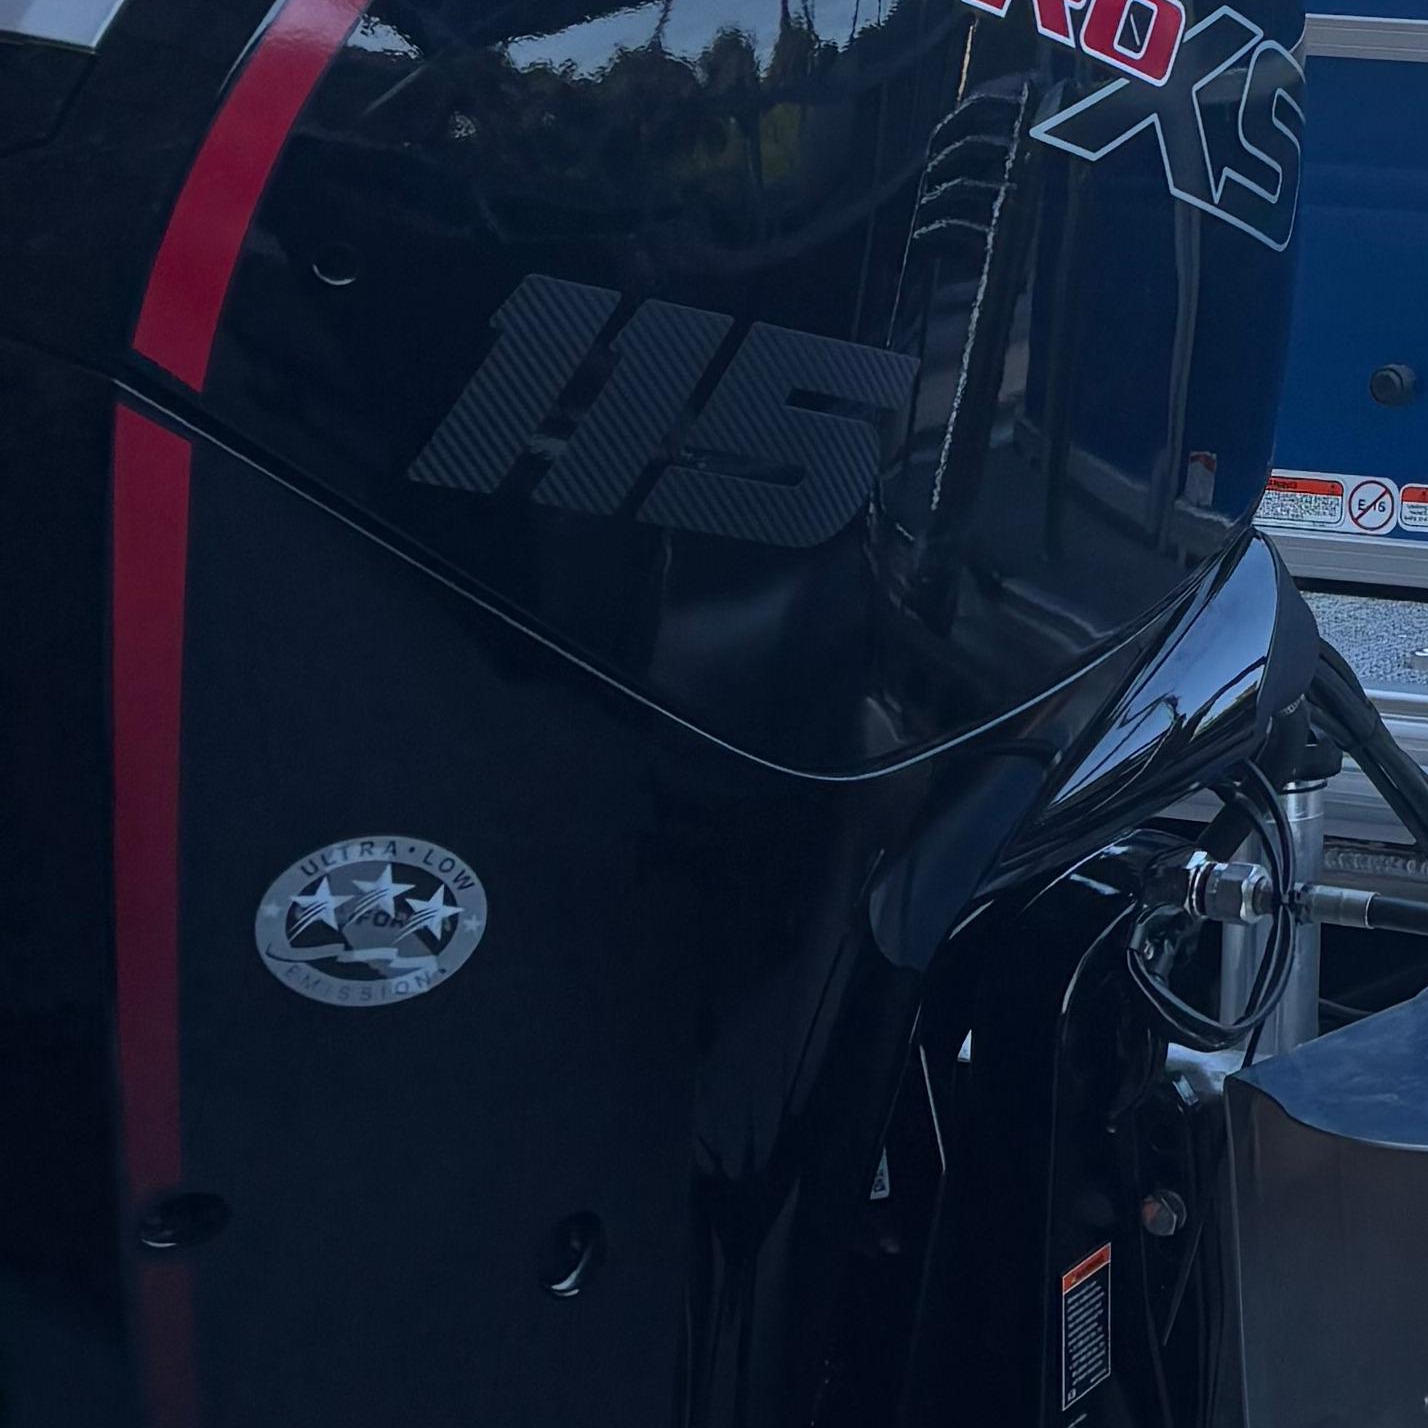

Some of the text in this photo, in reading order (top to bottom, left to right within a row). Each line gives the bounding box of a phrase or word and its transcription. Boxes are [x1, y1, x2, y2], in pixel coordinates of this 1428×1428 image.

[407, 273, 921, 548] 115
[300, 839, 475, 891] ULTRA LOW
[284, 963, 431, 1002] EMISSION
